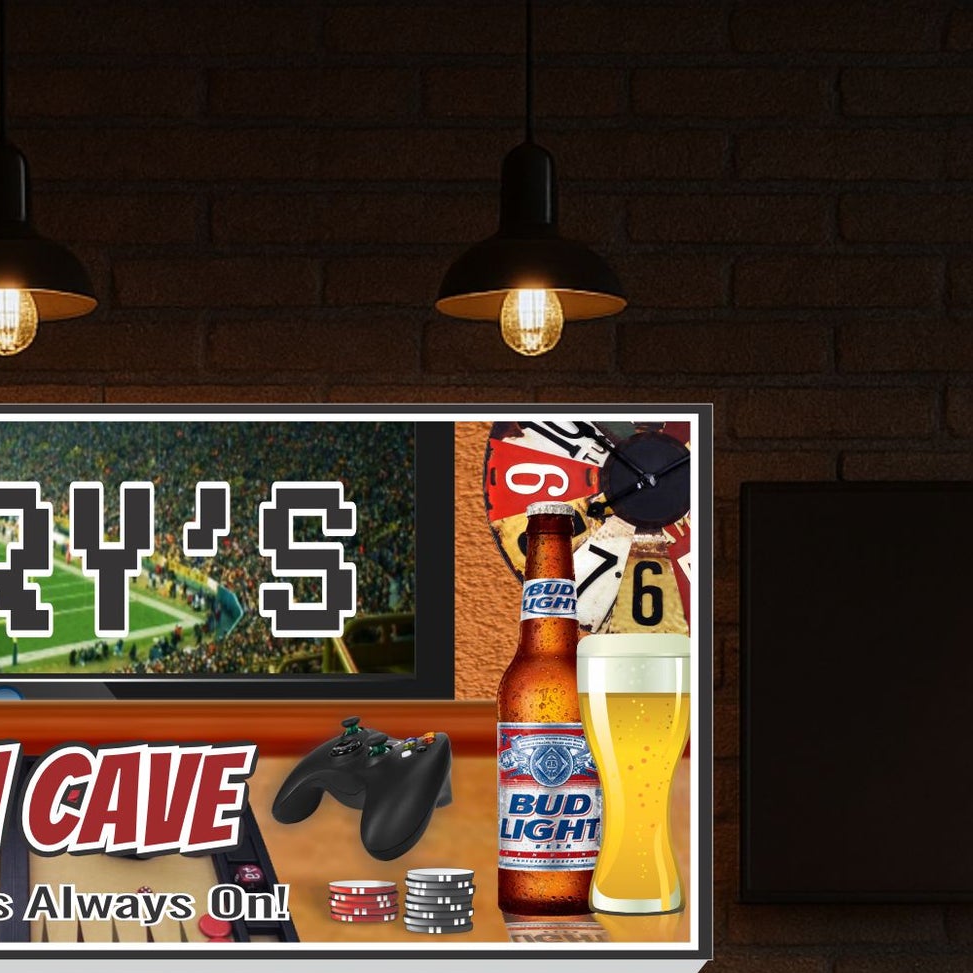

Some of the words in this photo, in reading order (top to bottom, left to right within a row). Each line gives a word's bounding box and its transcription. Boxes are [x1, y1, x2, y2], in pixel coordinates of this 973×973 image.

[505, 462, 569, 497] 9
[522, 596, 577, 611] LIGHT
[529, 582, 574, 596] BUD
[632, 560, 664, 627] 6
[22, 742, 258, 854] CAVE
[508, 793, 592, 817] BUD
[500, 818, 601, 842] LIGHT
[24, 884, 196, 926] Always
[208, 884, 290, 921] On!
